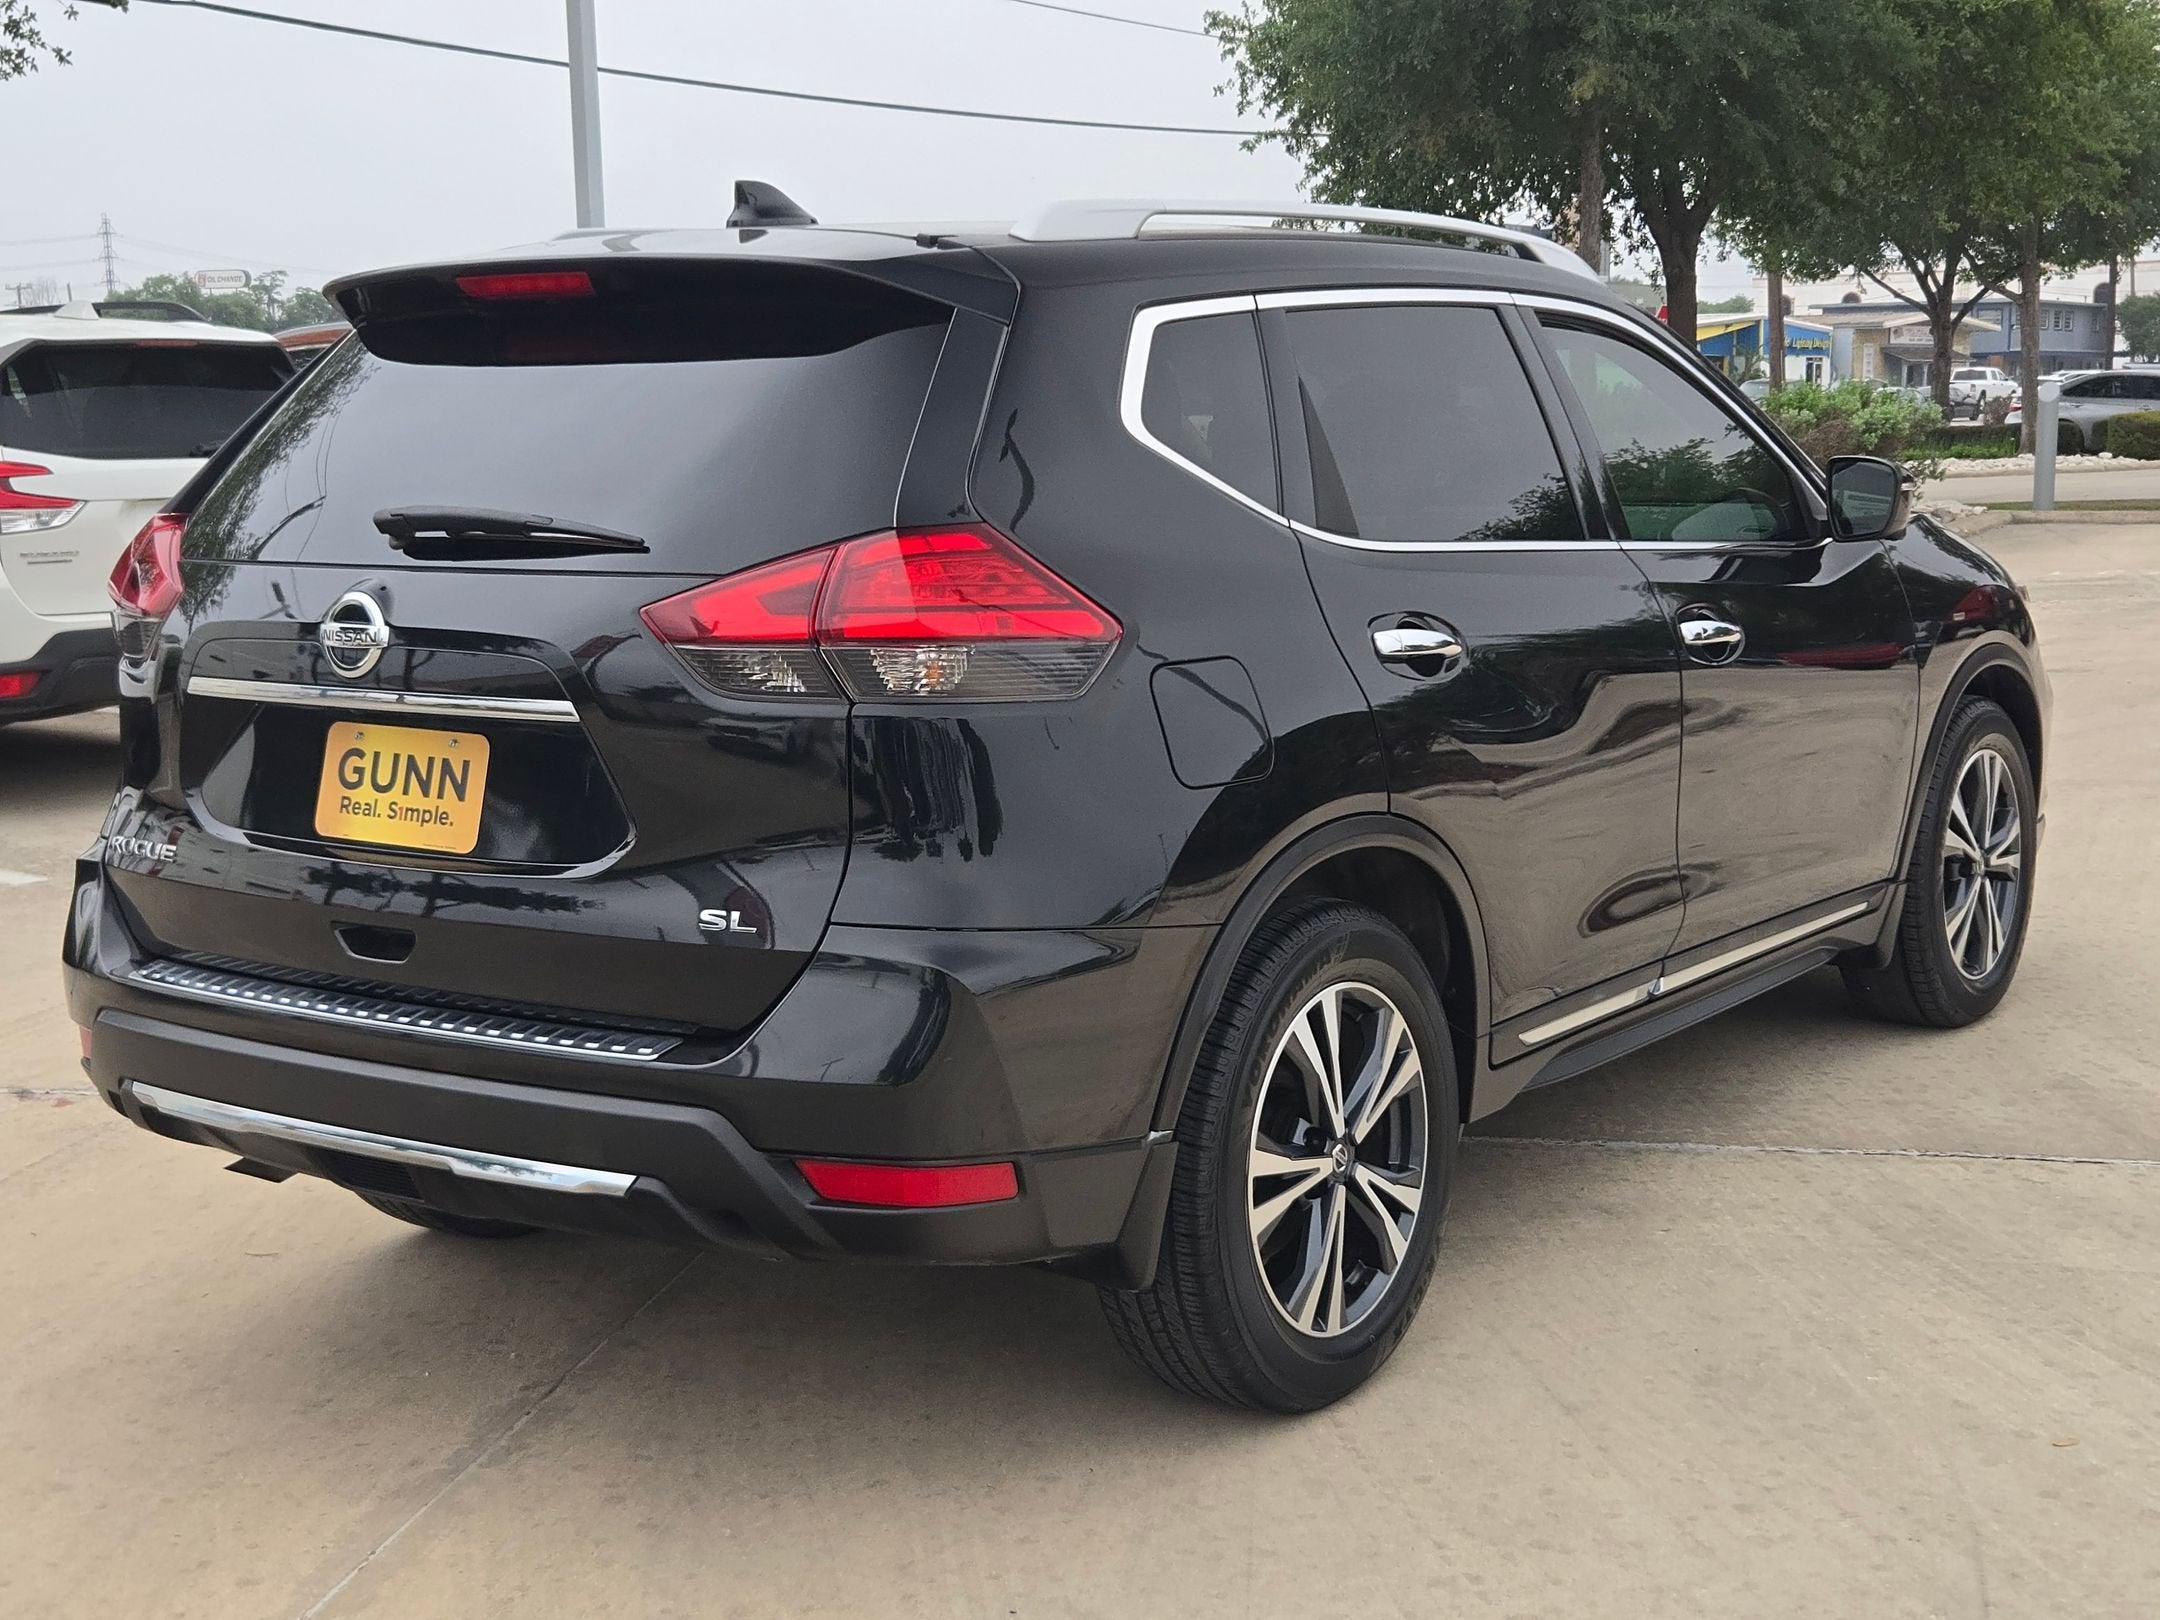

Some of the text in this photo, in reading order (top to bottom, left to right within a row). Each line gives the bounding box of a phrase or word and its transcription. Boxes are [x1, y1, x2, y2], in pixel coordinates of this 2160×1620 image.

[322, 628, 377, 643] NISSAN
[338, 747, 471, 802] GUNN
[339, 795, 382, 818] Real.
[112, 835, 177, 863] ROGUE
[699, 908, 758, 934] SL
